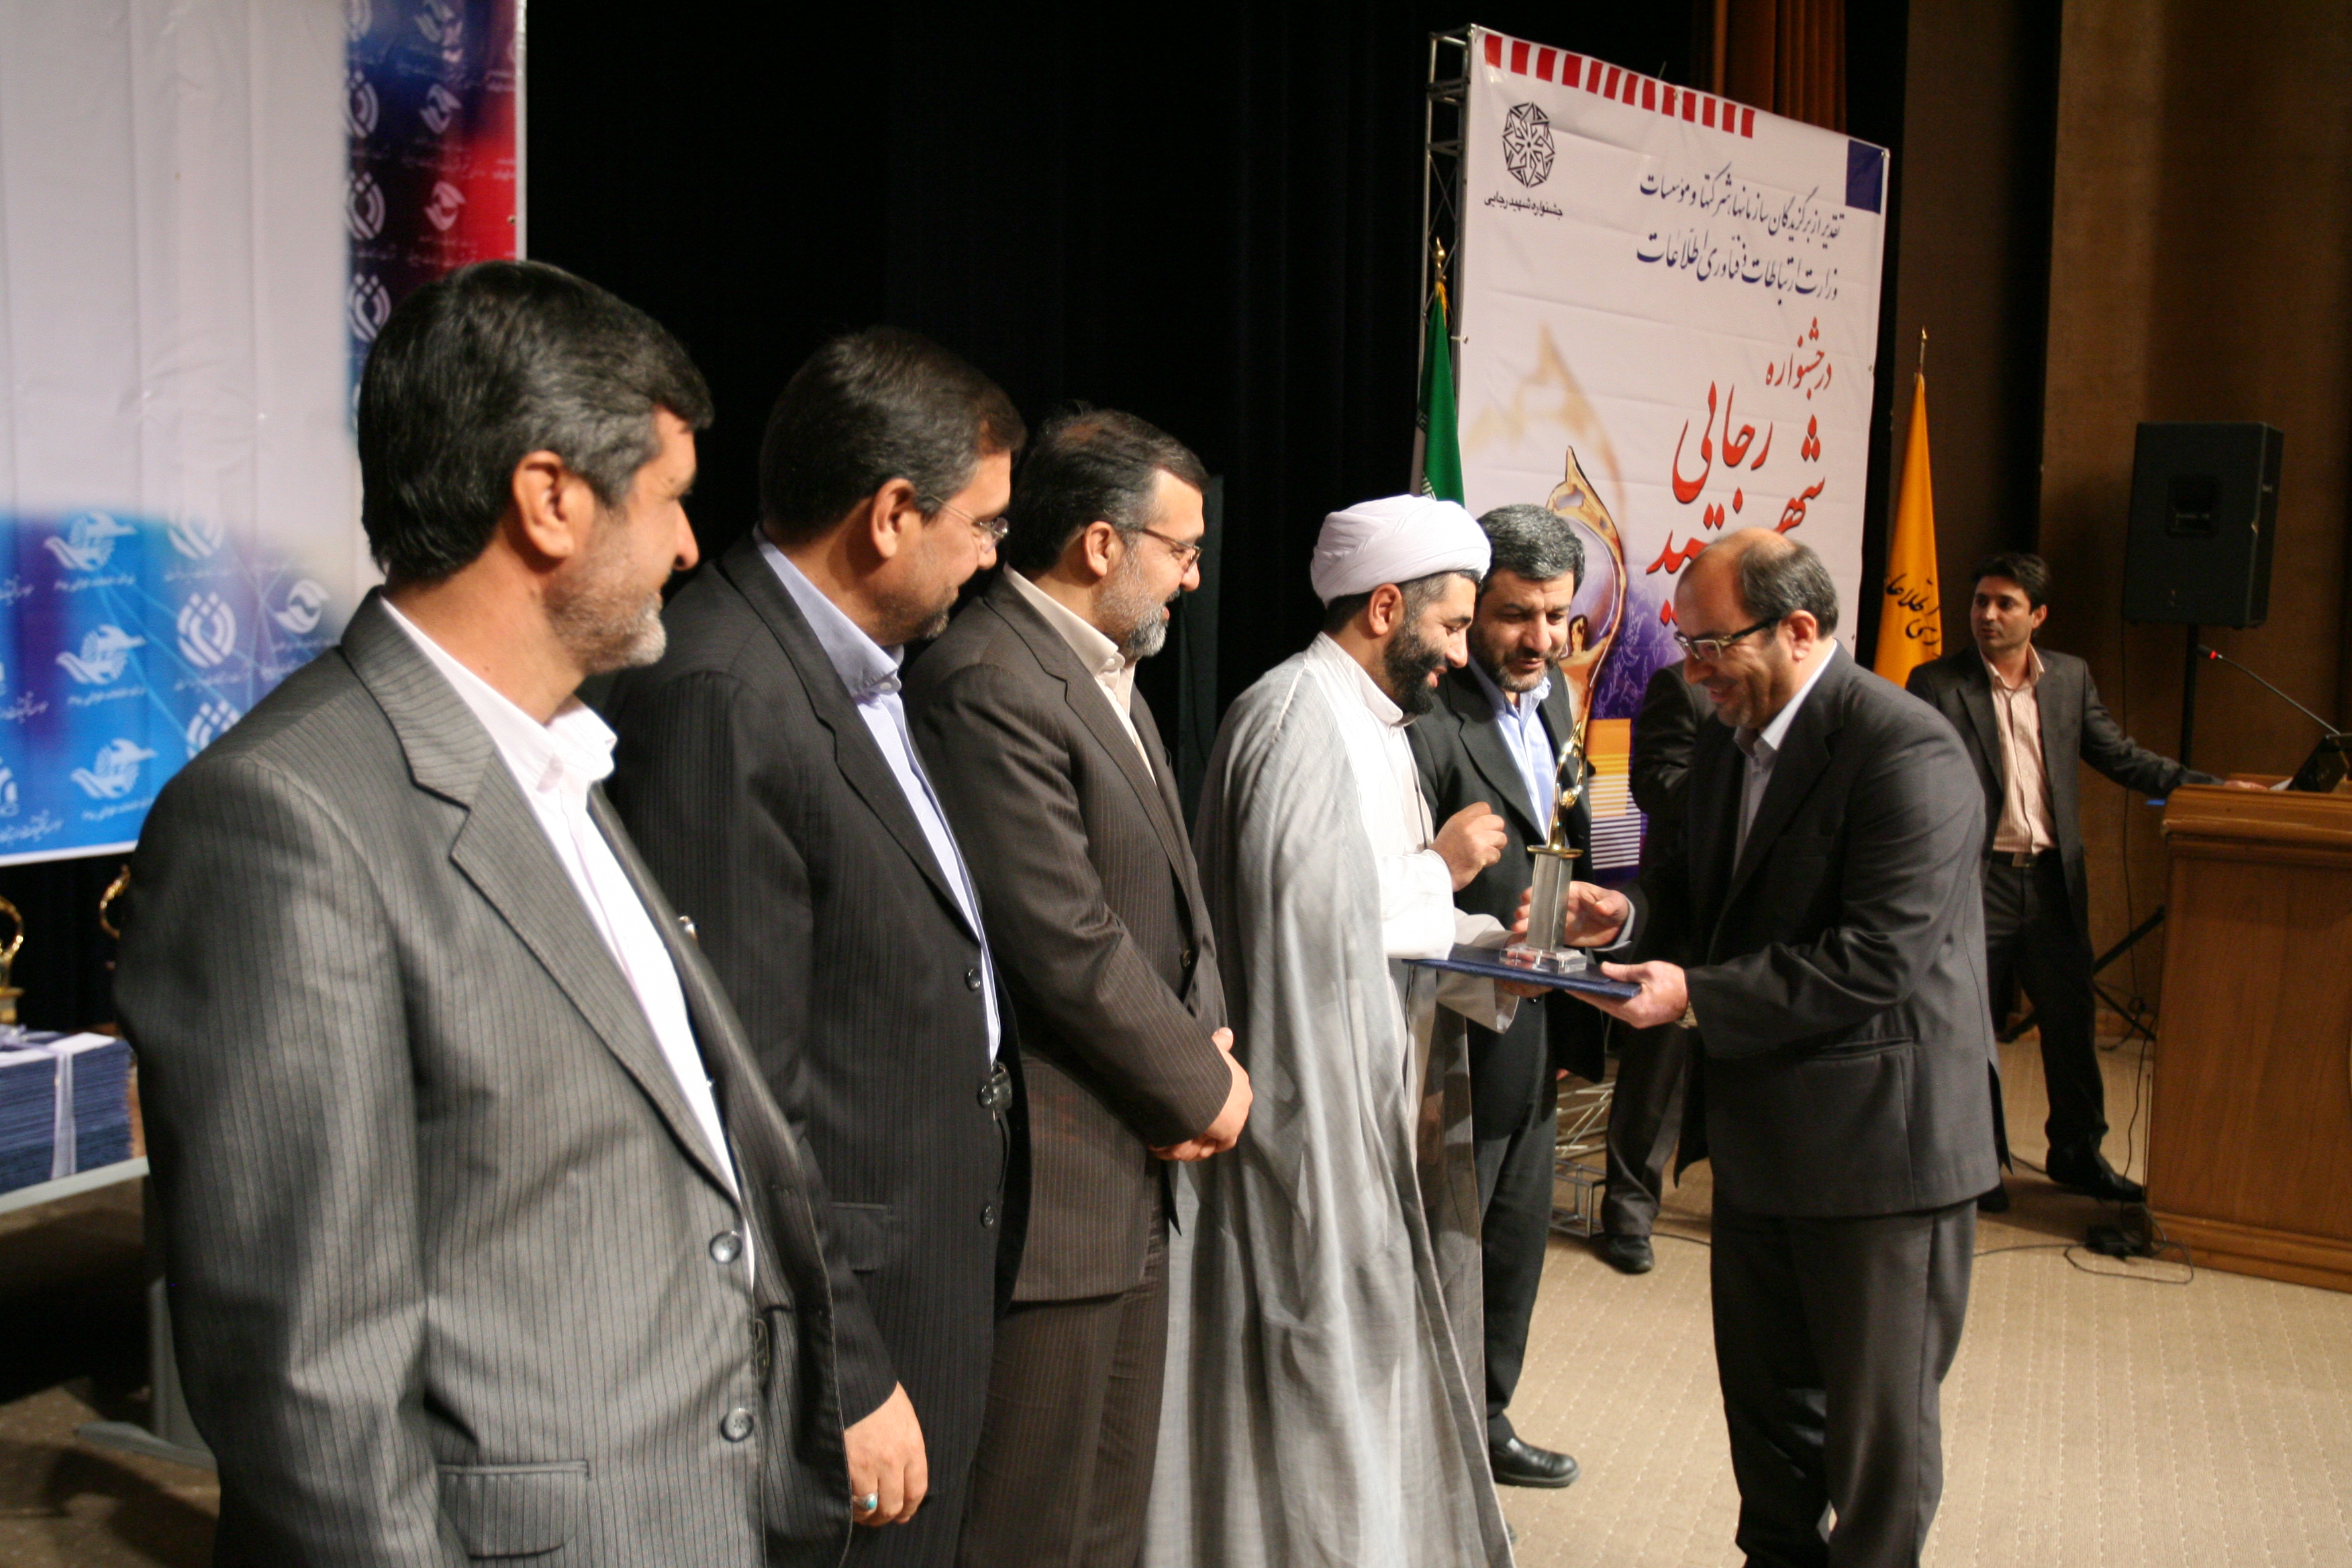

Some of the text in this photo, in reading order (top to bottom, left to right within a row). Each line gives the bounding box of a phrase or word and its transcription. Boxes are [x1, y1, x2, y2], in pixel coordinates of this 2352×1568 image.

[1509, 197, 1532, 211] شهید
[1689, 191, 1696, 206] و
[1700, 161, 1732, 217] شرکتها
[1531, 200, 1563, 220] جشنواره
[1767, 185, 1819, 244] برگزیدگان
[1810, 209, 1821, 234] از
[1820, 213, 1845, 249] تقدیر
[1741, 256, 1802, 306] ارتباطات
[1795, 267, 1838, 301] وزارت
[1765, 316, 1825, 401] جشنواره
